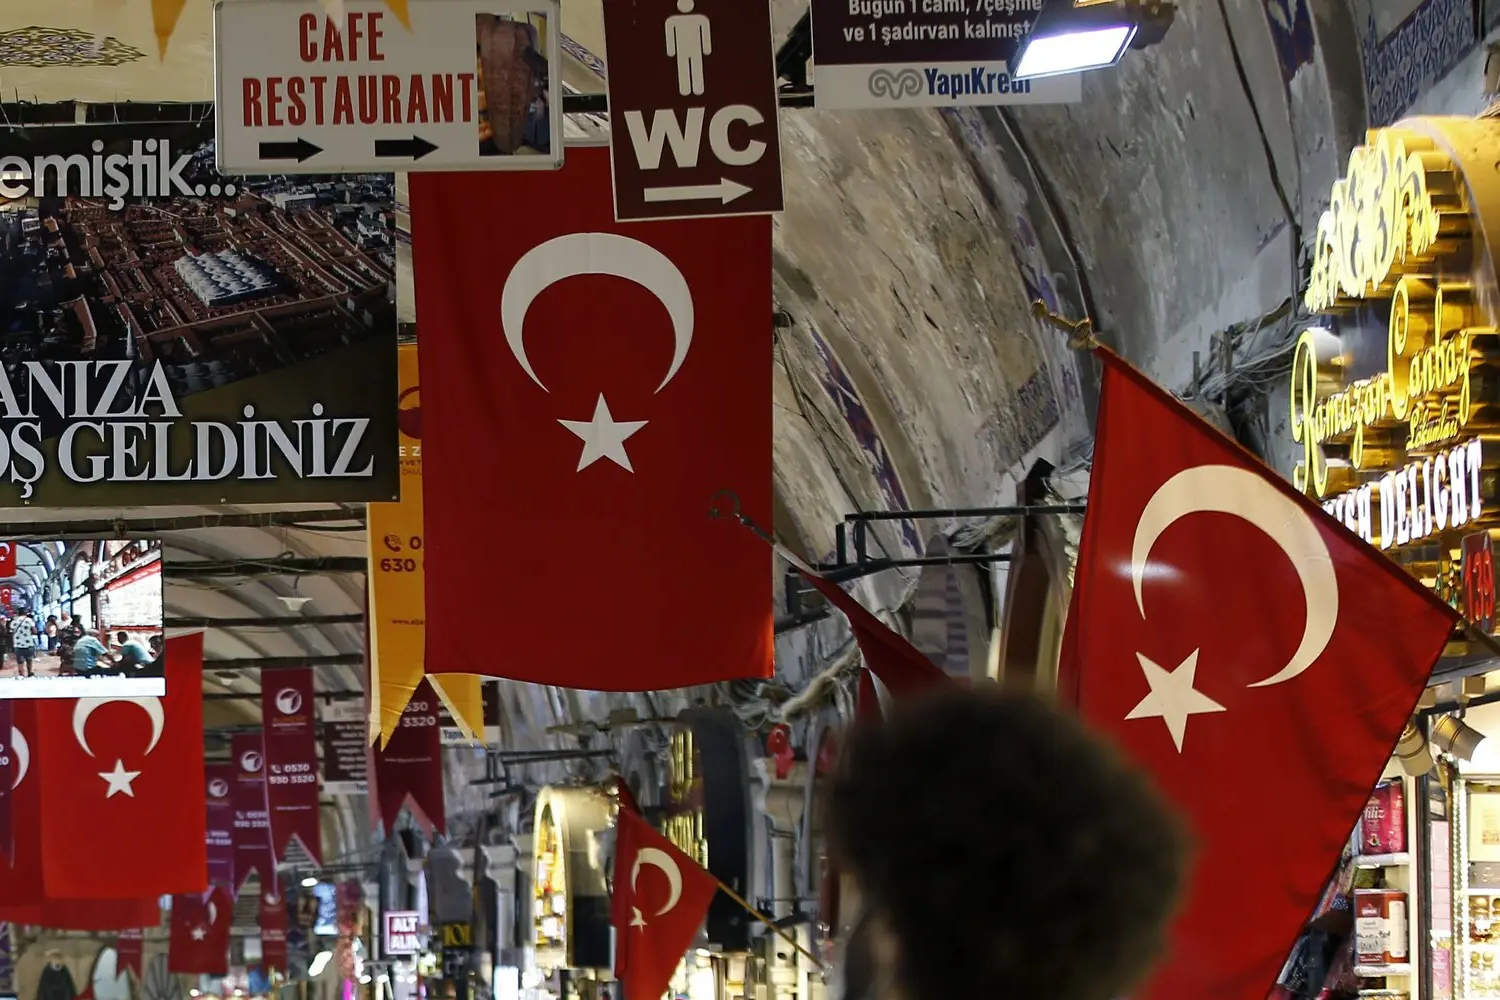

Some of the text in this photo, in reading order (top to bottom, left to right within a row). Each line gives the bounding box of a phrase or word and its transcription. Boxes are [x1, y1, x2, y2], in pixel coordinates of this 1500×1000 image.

[299, 12, 385, 63] CAFE
[843, 20, 1031, 45] ve 1 şadırvan kalmışt
[242, 73, 475, 127] RESTAURANT
[624, 104, 767, 170] WC
[59, 404, 375, 484] GELDİNİZ
[1380, 438, 1483, 551] DELIGHT
[380, 558, 416, 572] 630
